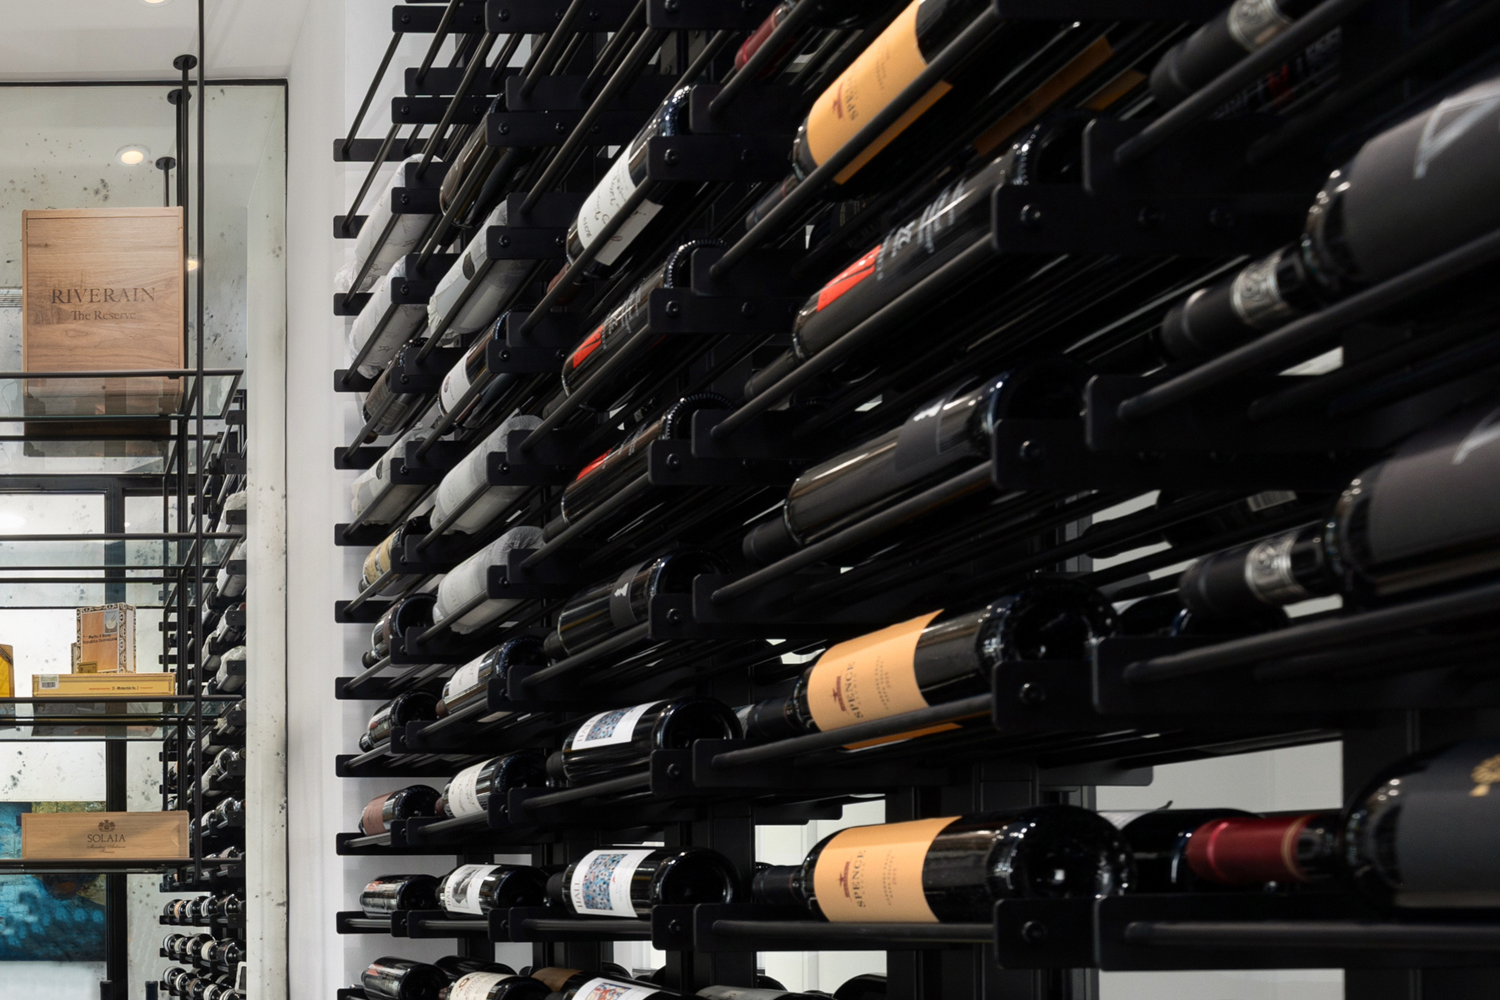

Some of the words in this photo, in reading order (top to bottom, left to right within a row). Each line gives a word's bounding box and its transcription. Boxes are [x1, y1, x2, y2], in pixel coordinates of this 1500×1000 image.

[50, 286, 157, 306] RIVERAIN
[70, 310, 91, 321] The
[93, 310, 137, 321] Reserve
[845, 660, 864, 720] SPENCE
[87, 833, 126, 843] SOLAIA
[852, 850, 867, 908] SPENCE
